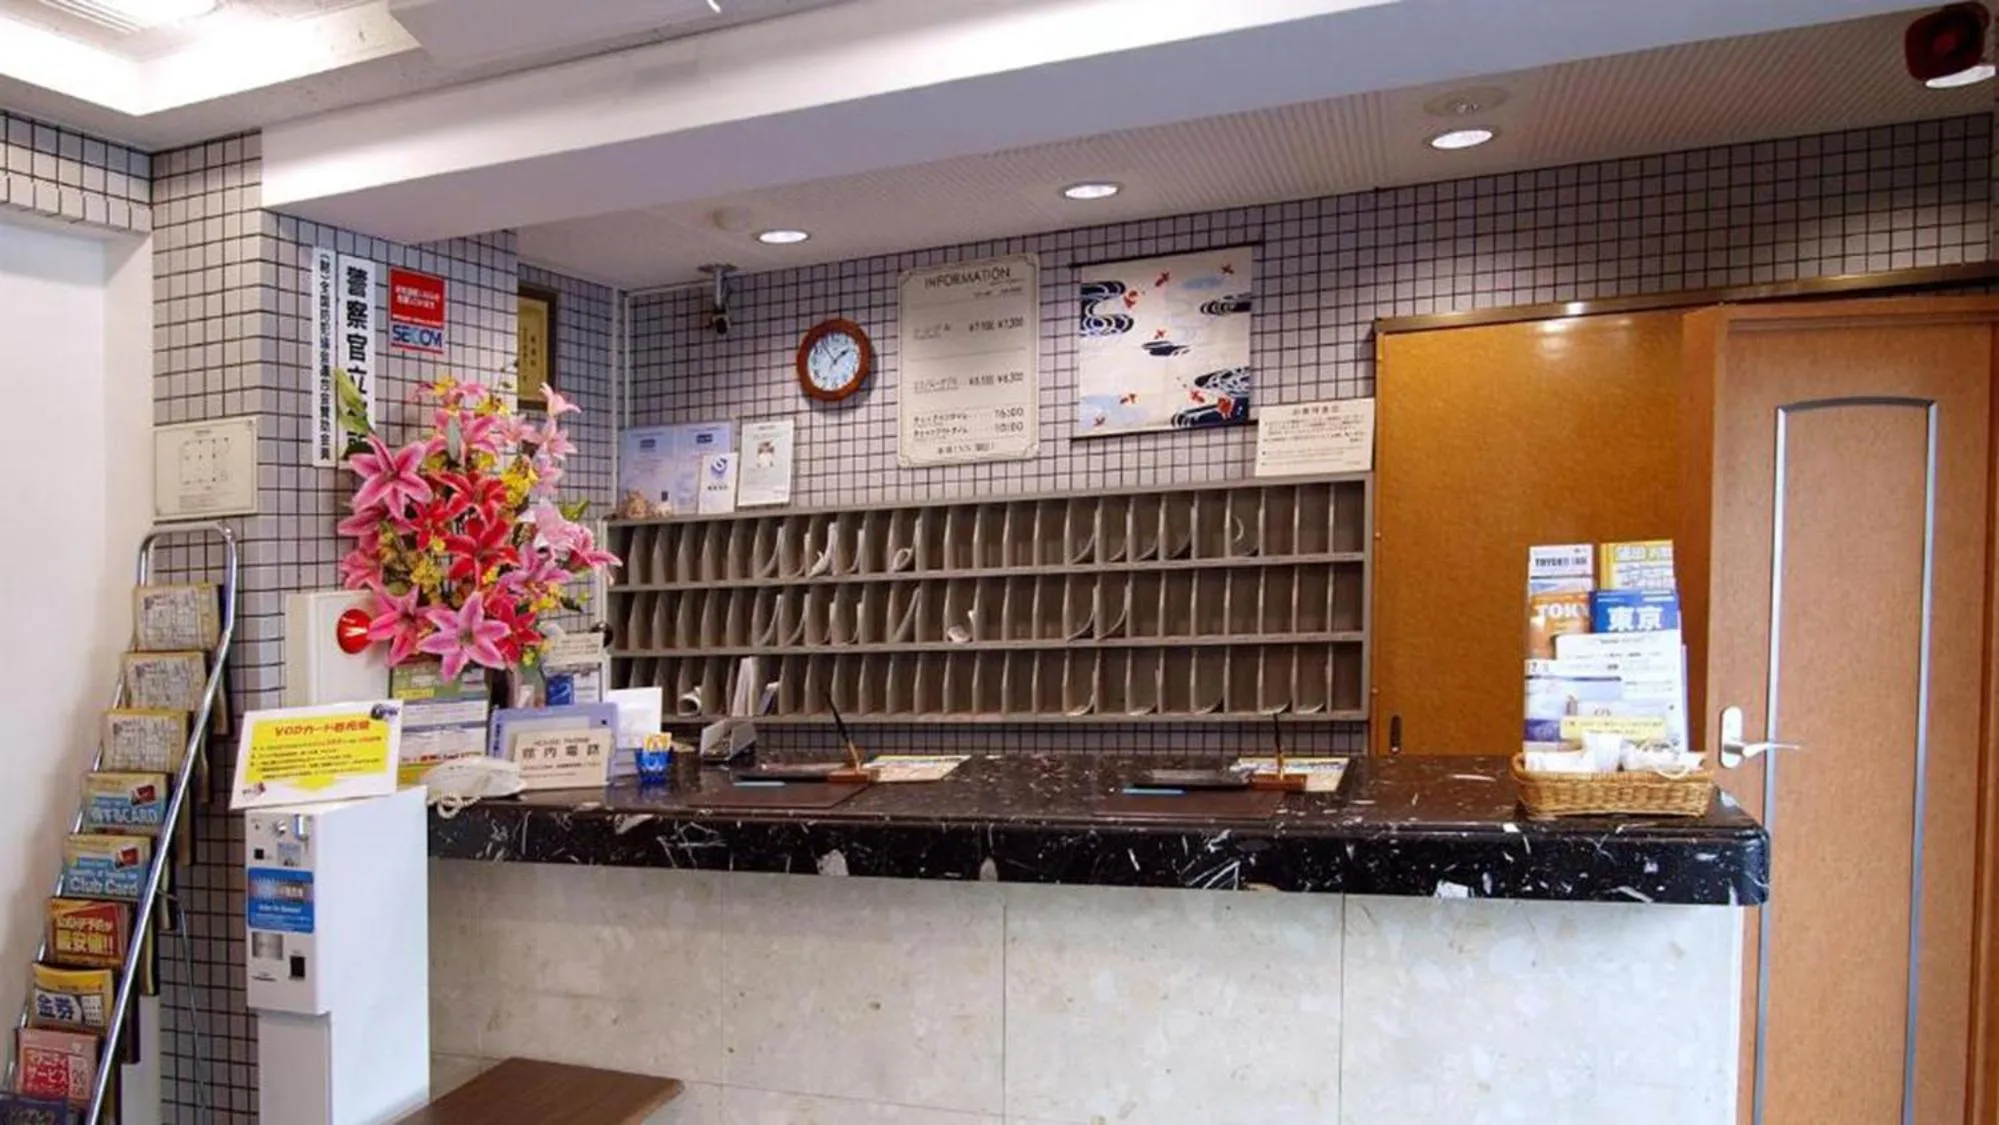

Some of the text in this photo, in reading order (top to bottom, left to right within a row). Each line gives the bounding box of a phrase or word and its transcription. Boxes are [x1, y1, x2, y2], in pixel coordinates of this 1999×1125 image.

[925, 266, 1010, 289] INFORMATION
[392, 324, 443, 348] SECOM
[1607, 605, 1664, 632] 東京
